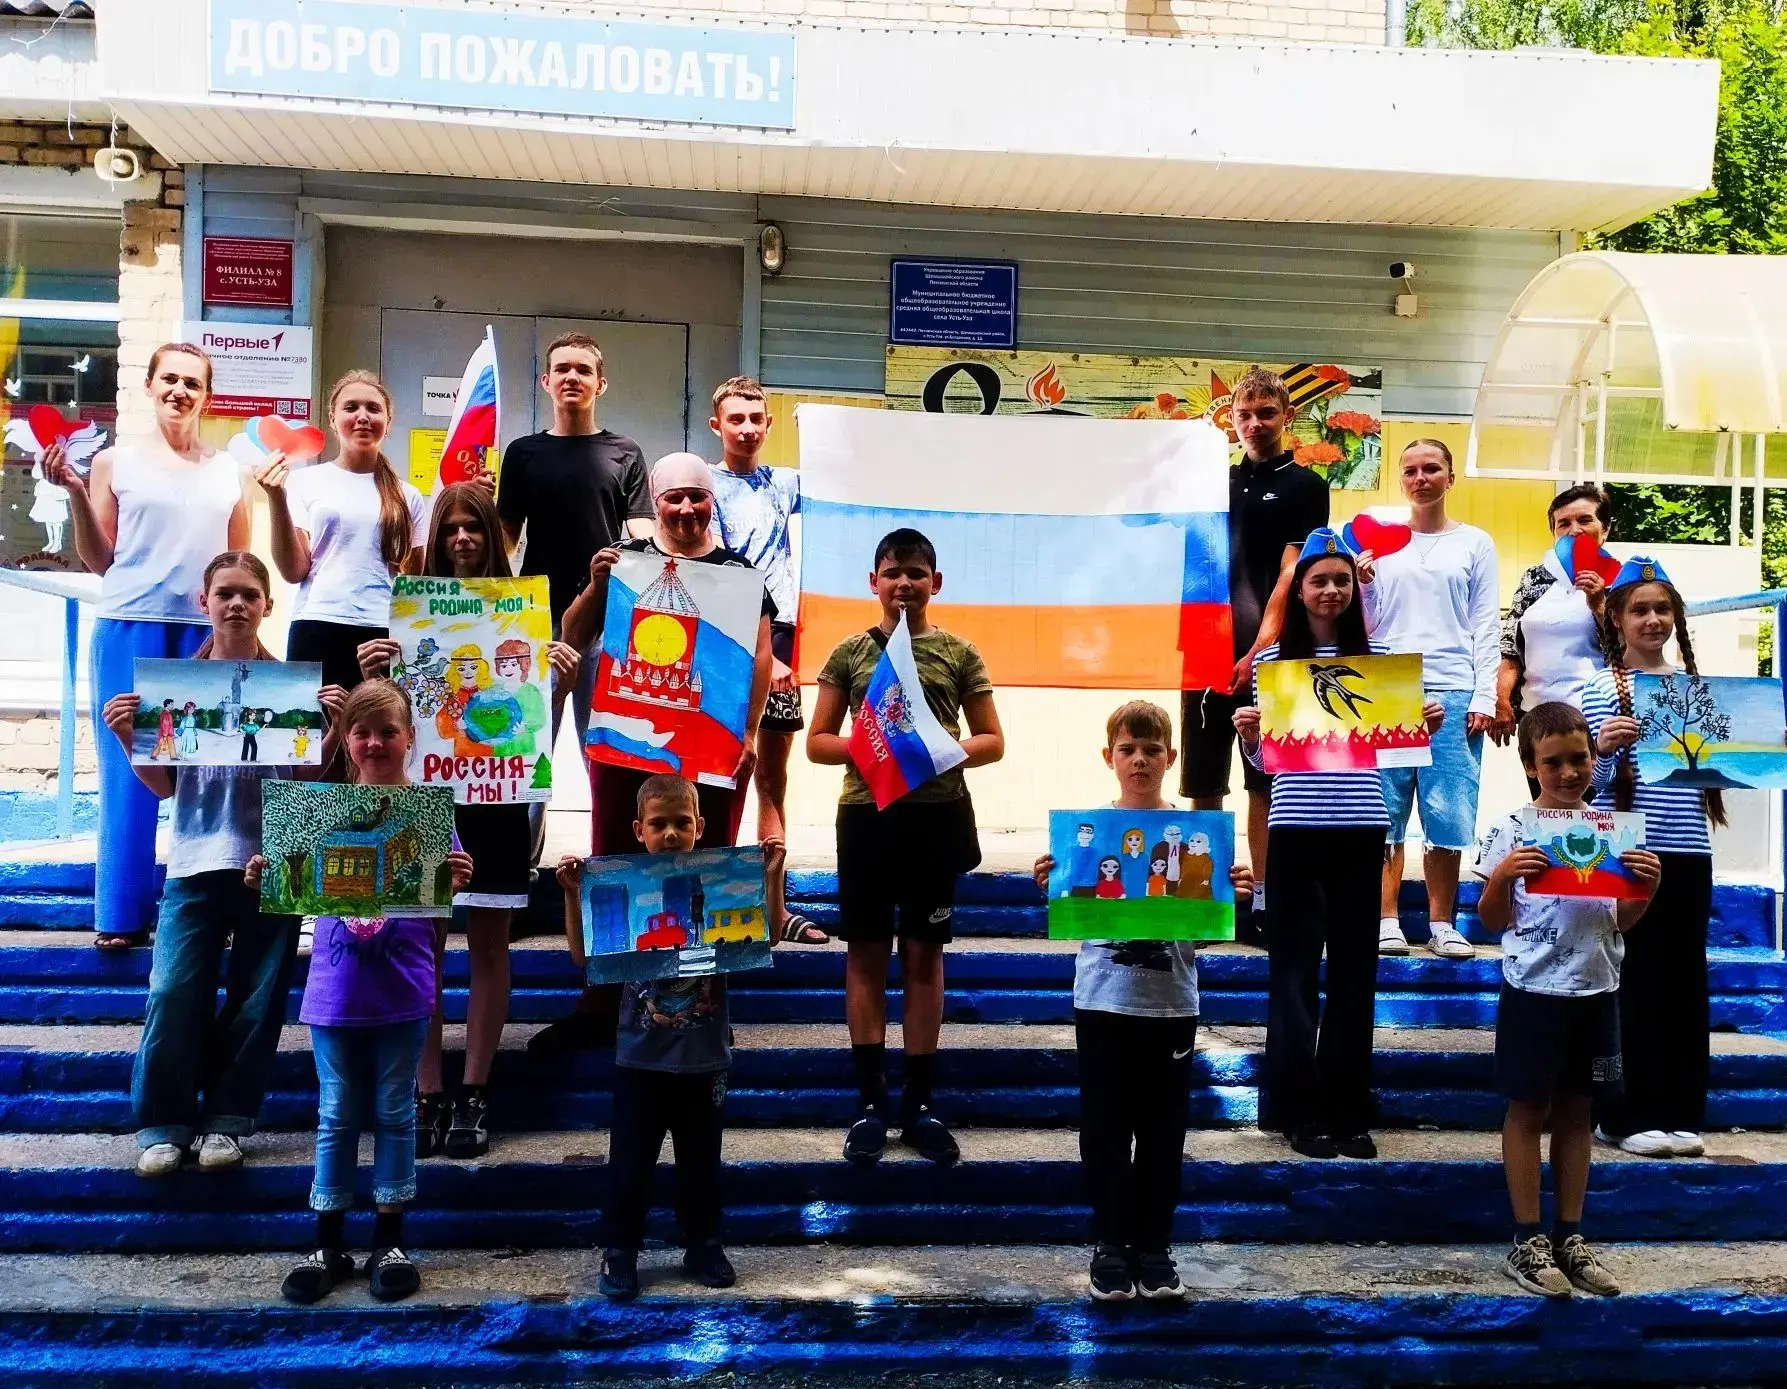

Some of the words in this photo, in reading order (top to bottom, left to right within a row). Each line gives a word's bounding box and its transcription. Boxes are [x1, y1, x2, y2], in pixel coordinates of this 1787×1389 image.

[225, 19, 400, 77] ДОБРО
[420, 32, 780, 103] ПОЖАЛОВАТЬ!
[216, 265, 262, 276] ФИЛИАЛ
[276, 268, 282, 277] 8
[912, 289, 960, 297] Муниципальное
[961, 291, 995, 299] бюджетное
[900, 296, 969, 306] общеобразовательное
[922, 305, 990, 313] общеобразовательная
[203, 333, 270, 351] Первые
[234, 354, 280, 362] отделение
[428, 598, 483, 616] РОДИНА
[1537, 809, 1573, 820] РОССИЯ
[1581, 811, 1614, 822] РОДИНА
[1597, 822, 1615, 832] МОЯ
[935, 907, 951, 917] NIKE
[1521, 927, 1558, 944] NIKE
[294, 1260, 327, 1271] adidas
[378, 1258, 413, 1268] adidas
